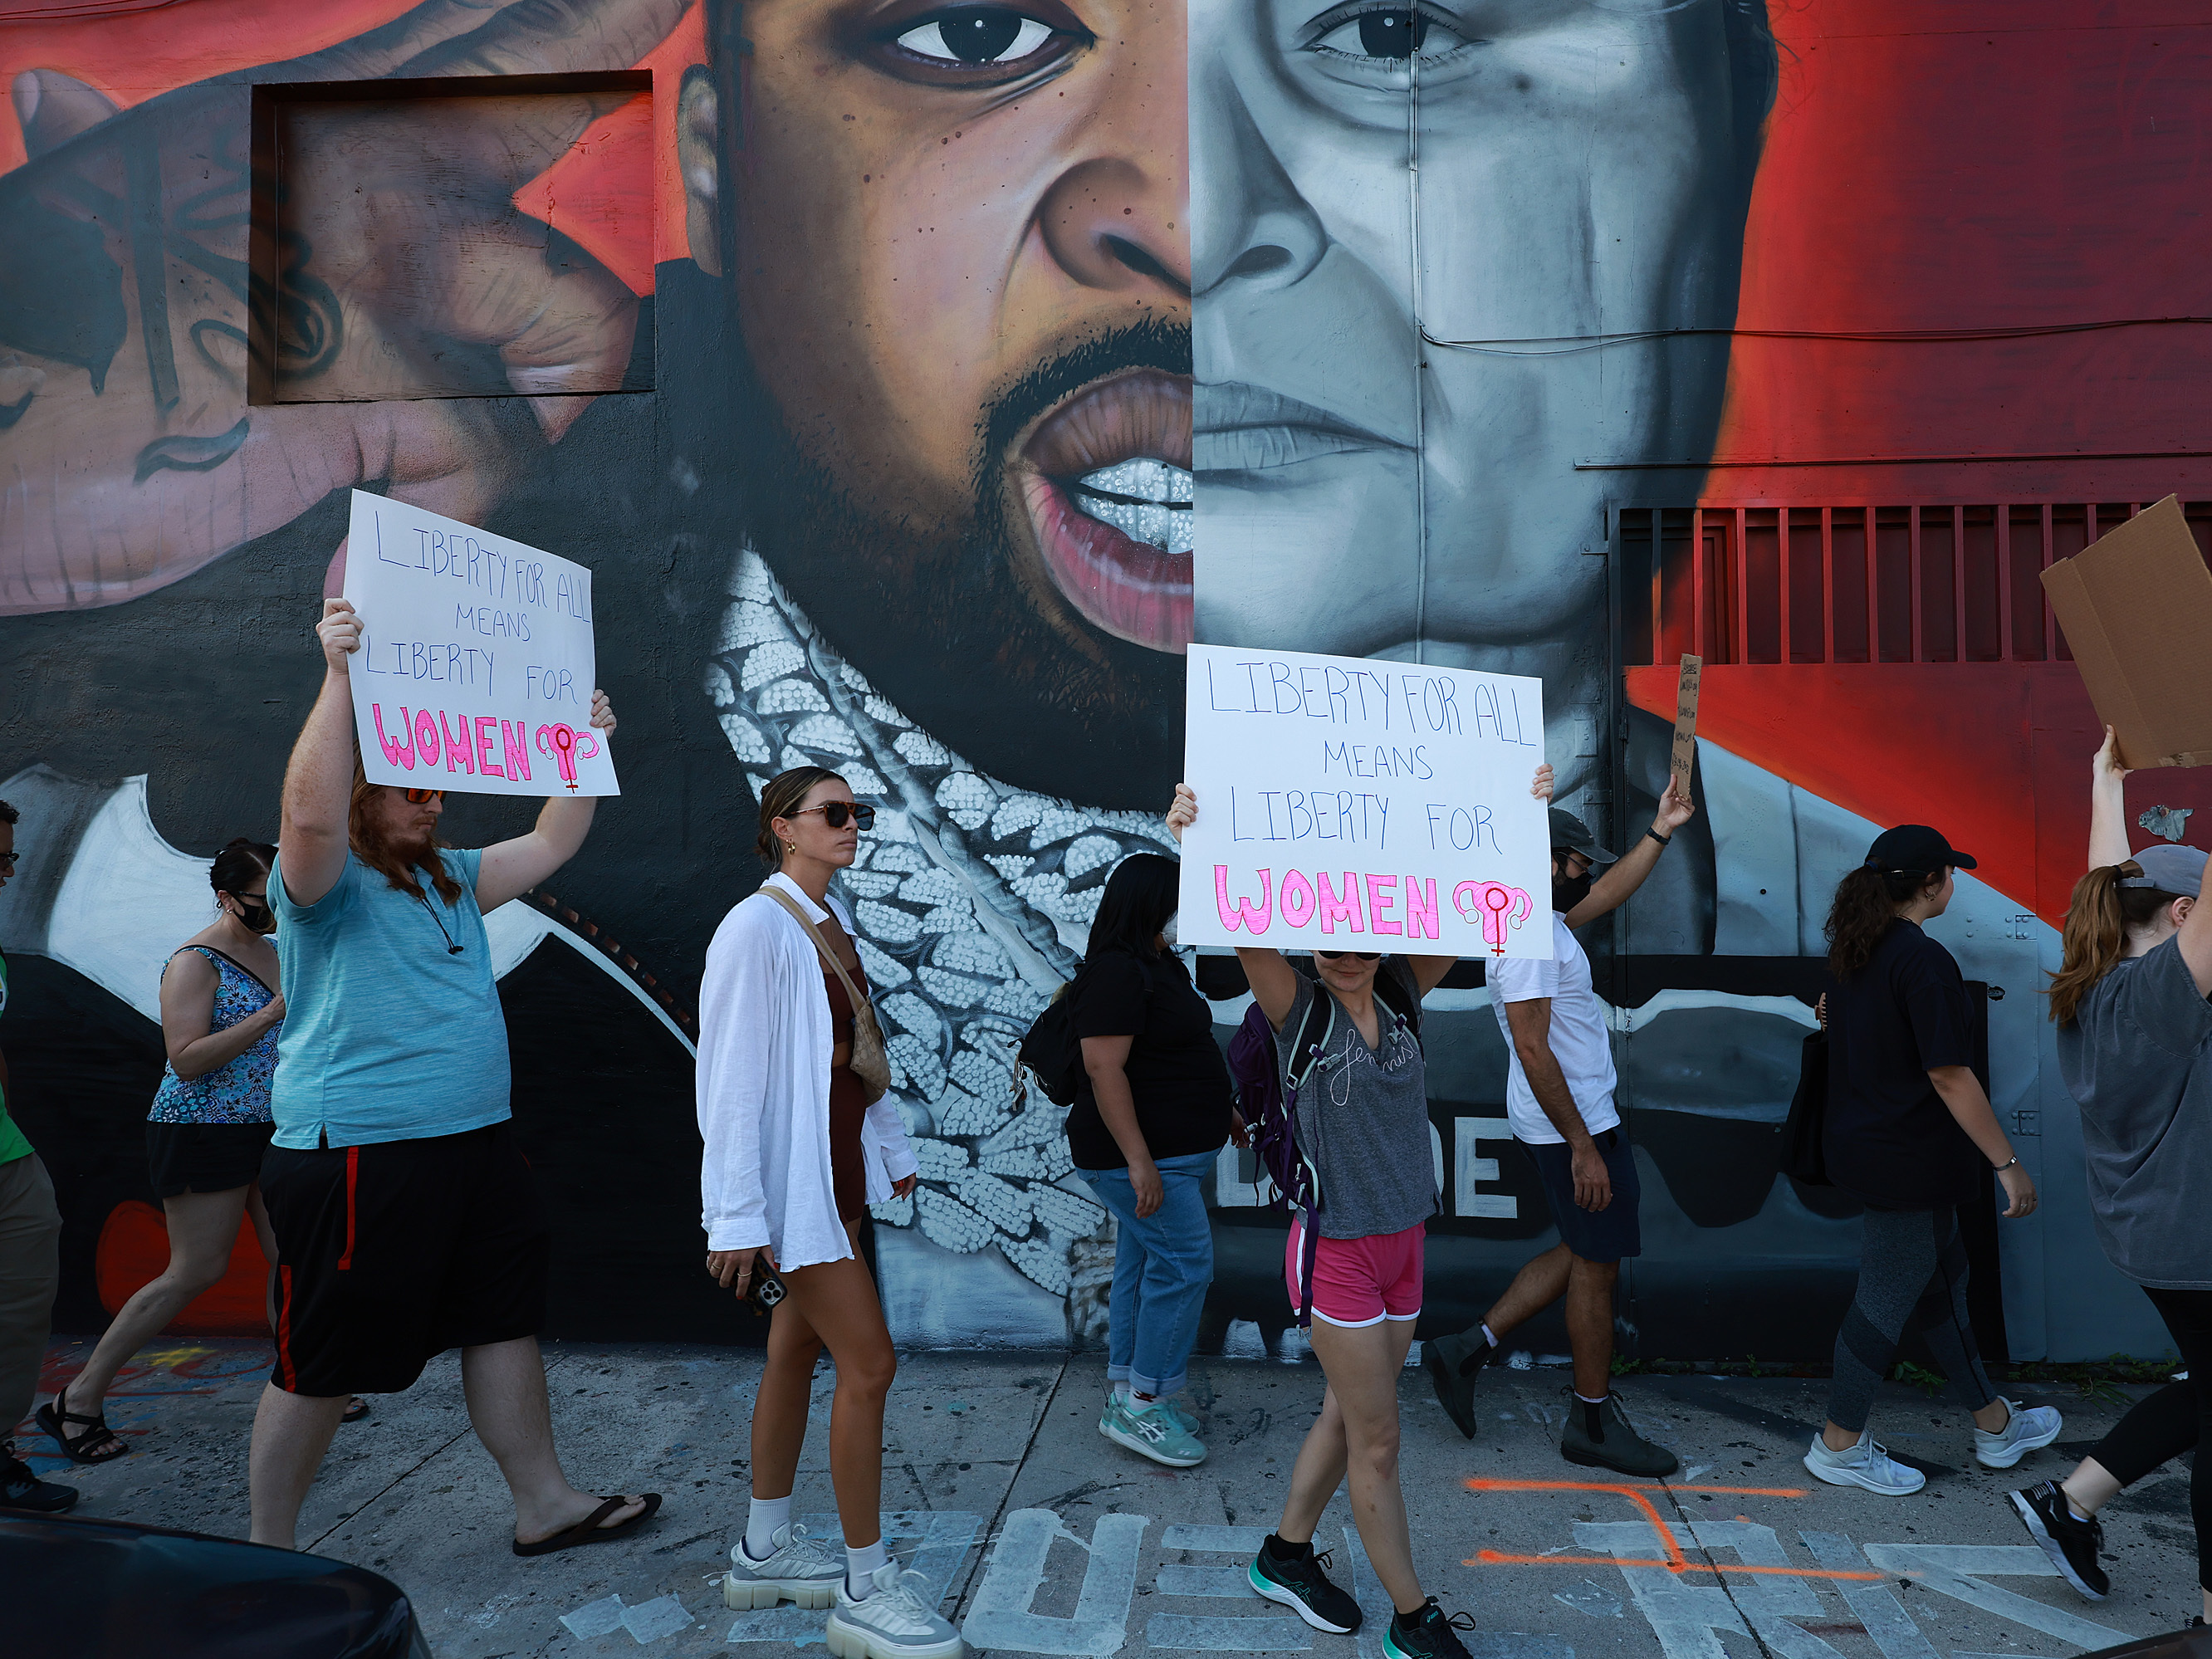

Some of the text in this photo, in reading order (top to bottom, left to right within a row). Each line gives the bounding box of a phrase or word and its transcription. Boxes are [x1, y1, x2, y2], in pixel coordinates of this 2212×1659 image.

[374, 510, 592, 623] LIBERTY FOR ALL
[455, 603, 531, 642] MEANS
[366, 634, 579, 705] LIBERTY FOR
[1206, 658, 1538, 746] LIBERTY FOR ALL
[371, 702, 532, 781] WOMEN
[1324, 740, 1434, 781] MEANS
[1230, 785, 1504, 855] LIBERTY FOR
[1212, 864, 1441, 940] WOMEN
